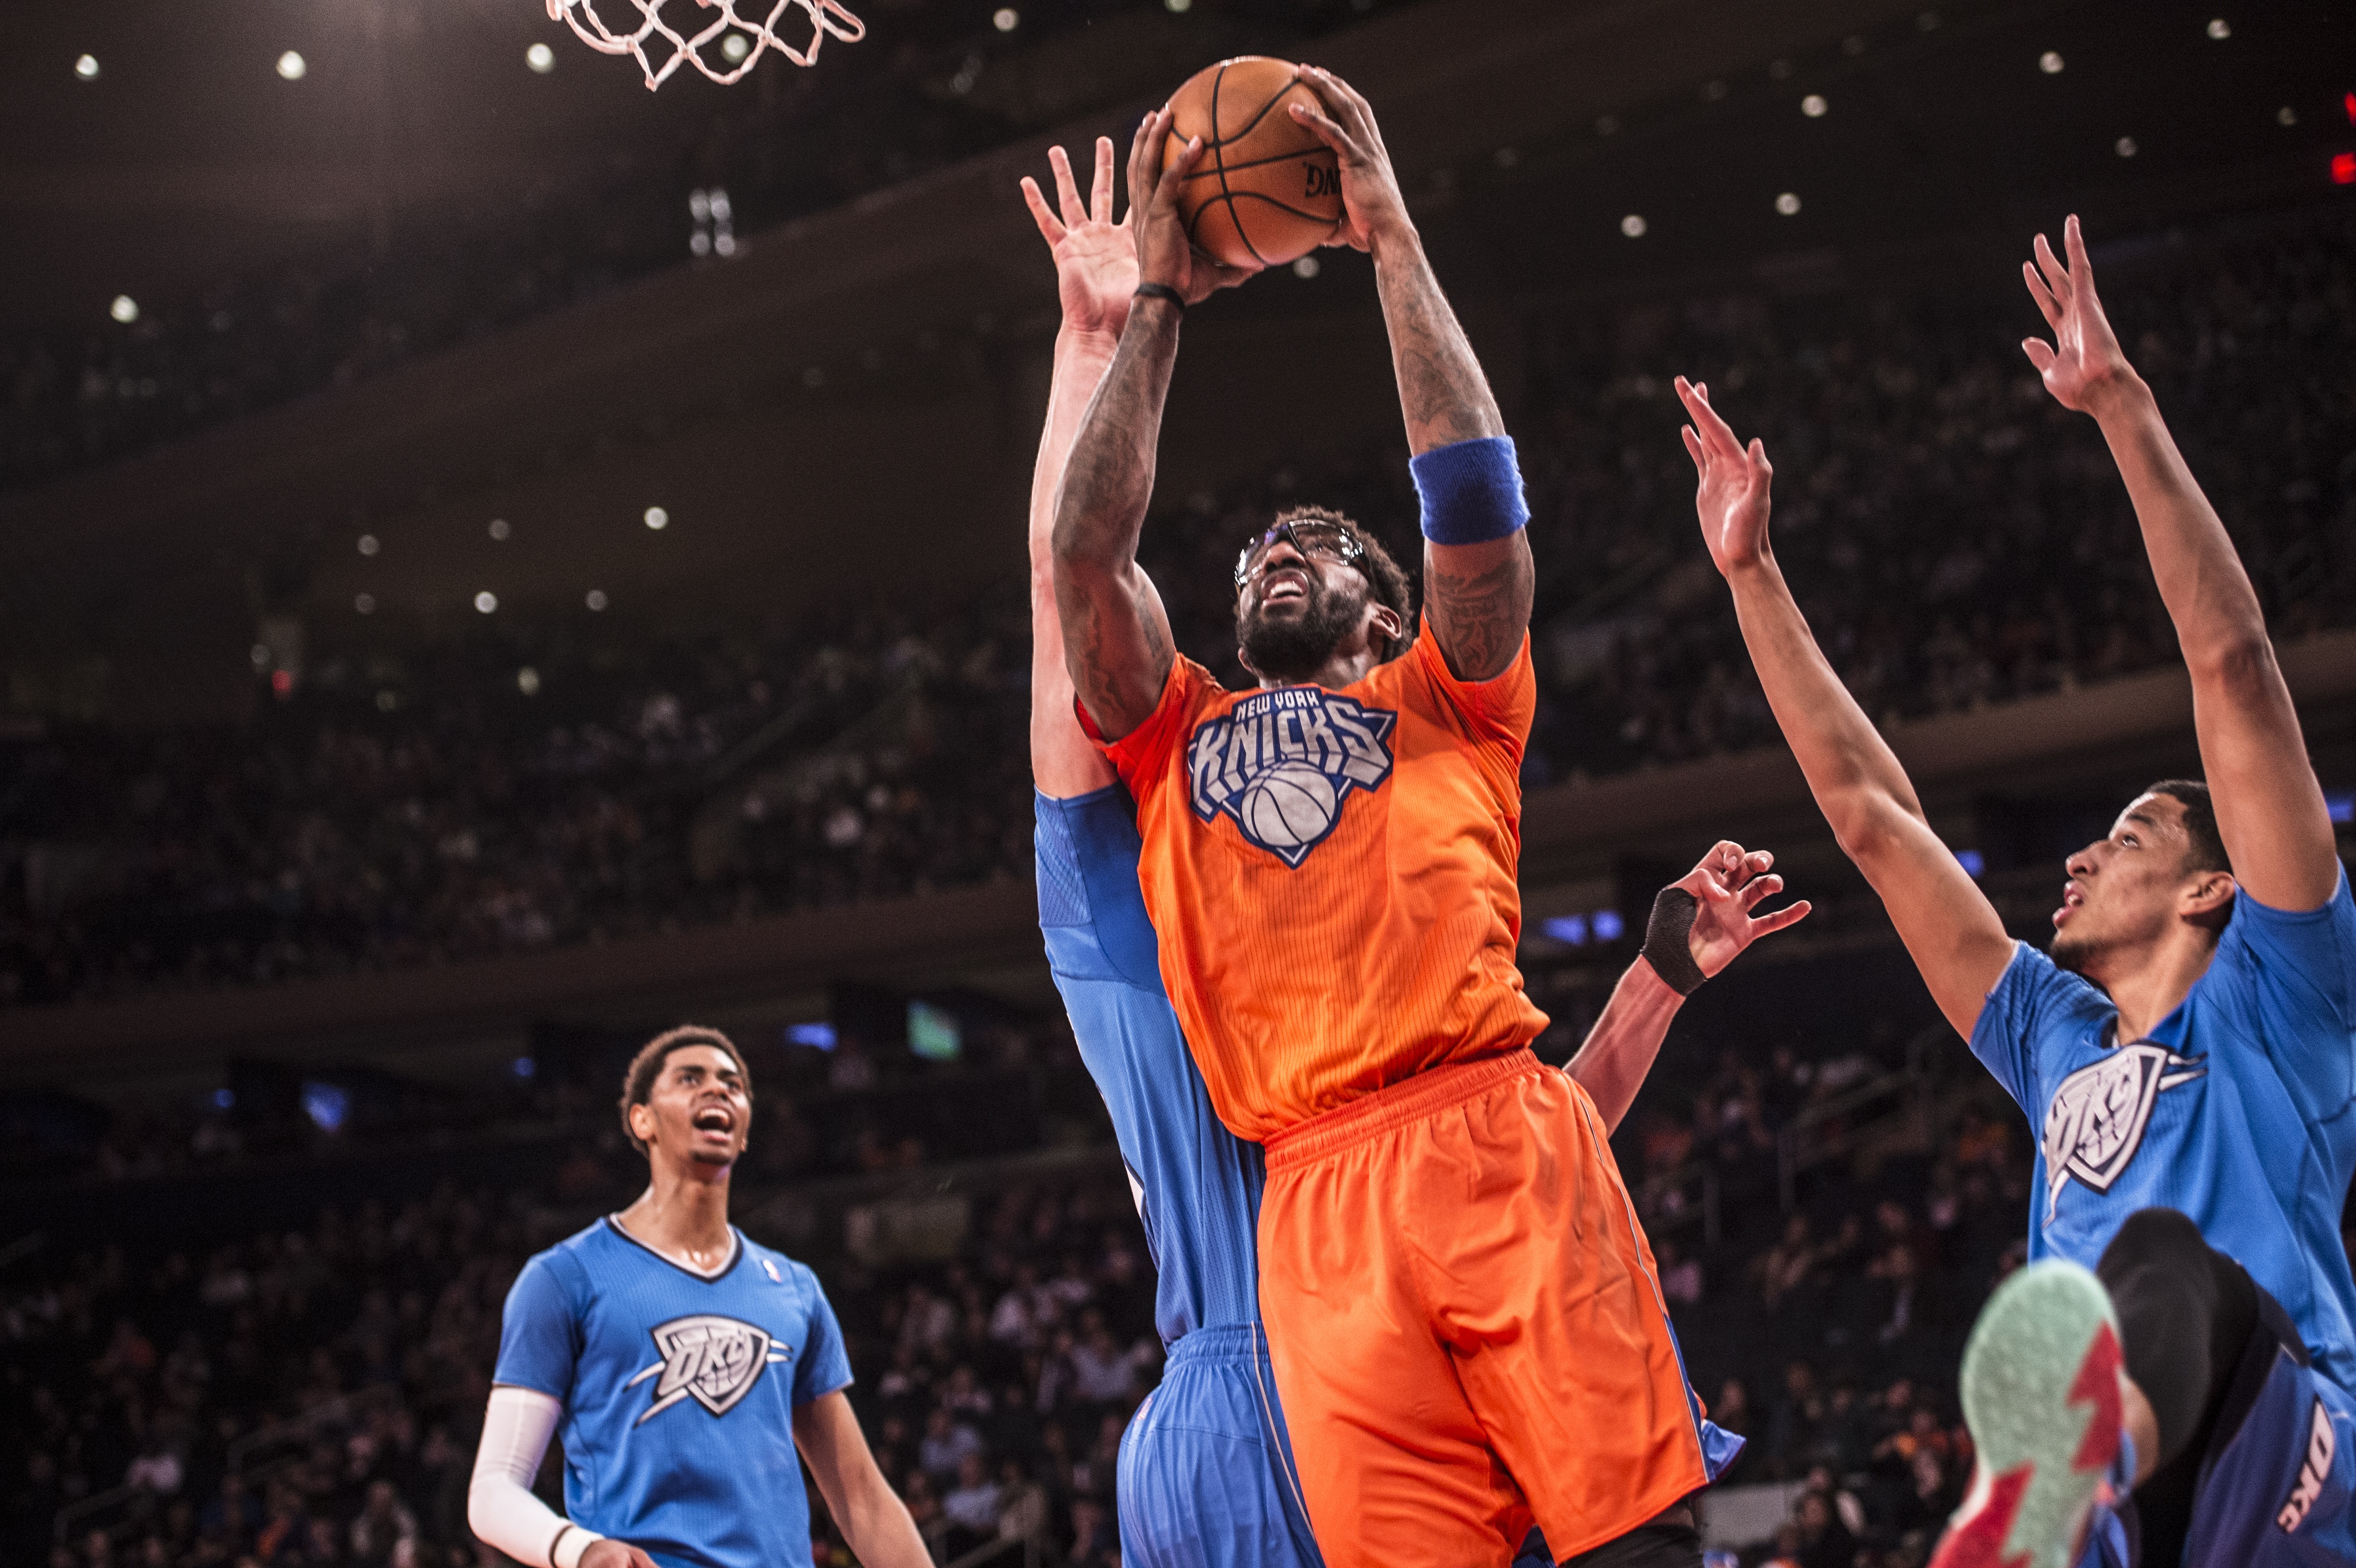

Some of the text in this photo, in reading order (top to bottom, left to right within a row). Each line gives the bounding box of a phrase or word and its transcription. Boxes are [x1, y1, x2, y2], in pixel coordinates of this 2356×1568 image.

[1235, 690, 1320, 723] NEW YORK
[1193, 699, 1390, 815] KNICKS
